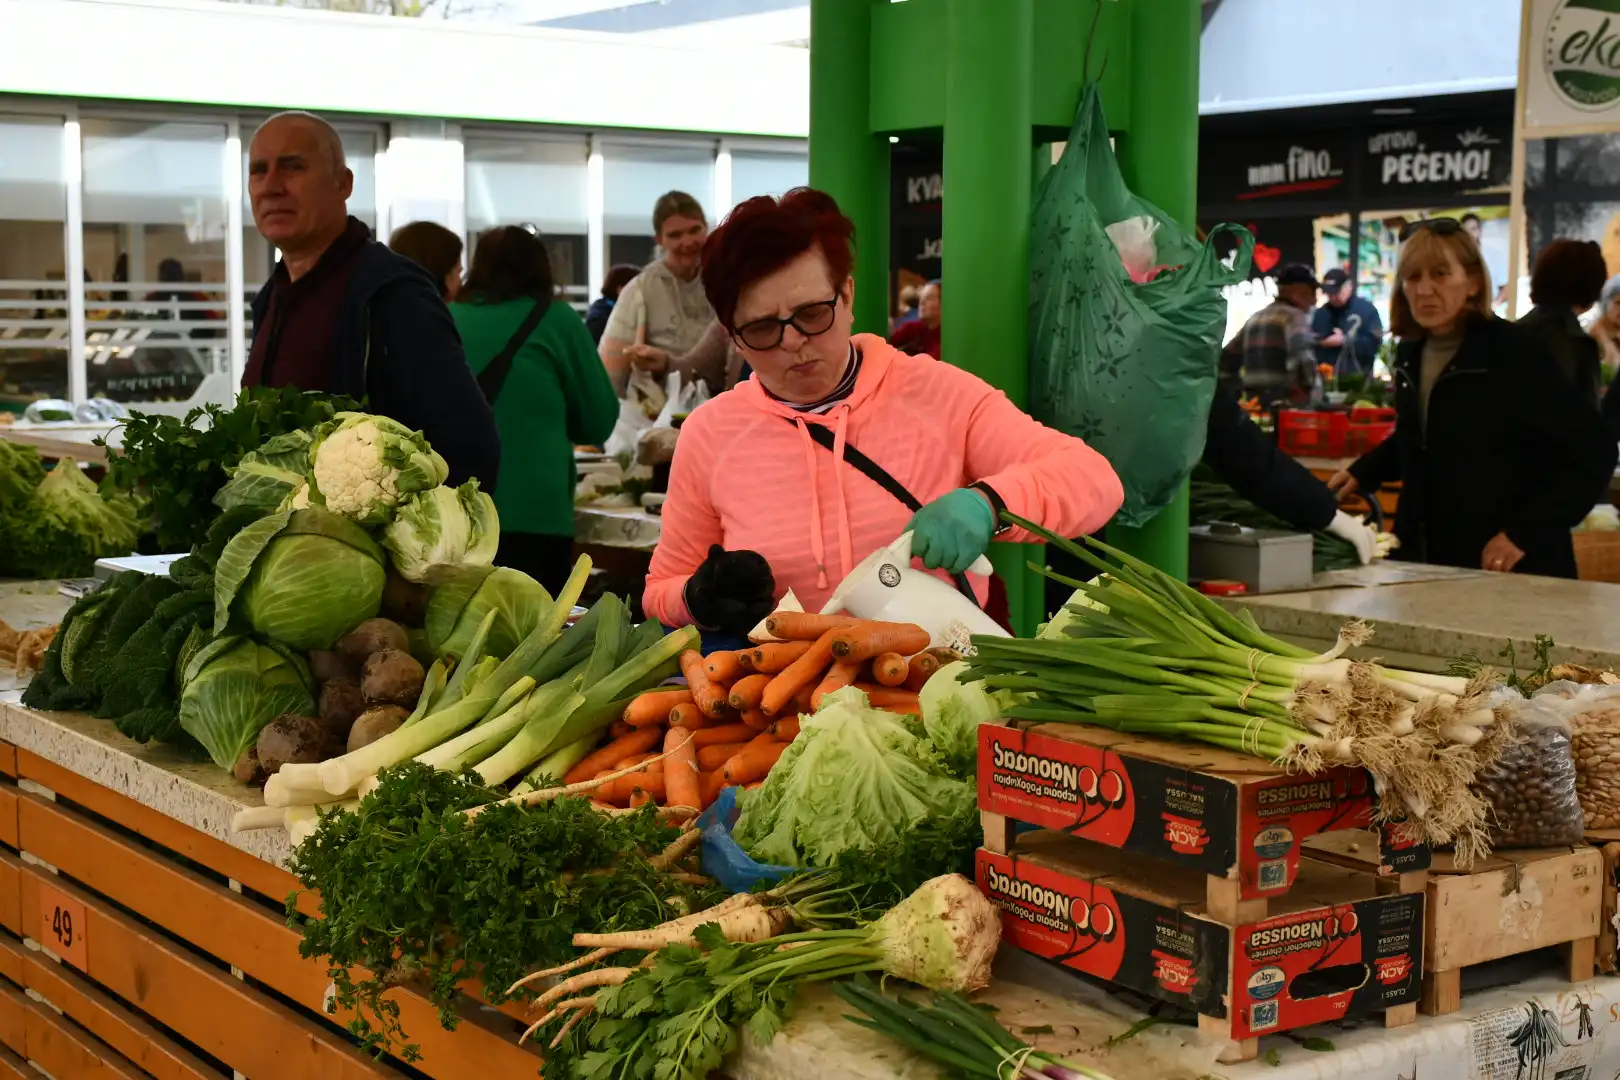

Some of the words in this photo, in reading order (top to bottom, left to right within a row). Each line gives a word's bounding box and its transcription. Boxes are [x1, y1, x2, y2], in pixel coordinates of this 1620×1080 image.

[1381, 143, 1491, 184] PEČENO!
[994, 741, 1077, 790] Νάουσας
[993, 774, 1042, 796] Ροδοχωρίου
[1257, 780, 1331, 805] Naoussa
[1043, 787, 1077, 804] κεράσια
[1256, 805, 1291, 818] cherries
[1291, 799, 1331, 813] Rodochori
[1168, 829, 1199, 847] ACN
[988, 866, 1070, 920] Νάουσας
[52, 905, 73, 948] 49
[1036, 914, 1069, 932] κεράσια
[1252, 920, 1323, 947] Naoussa
[1377, 933, 1410, 944] NAOUSSA
[1251, 946, 1283, 961] cherries
[1283, 940, 1323, 955] Rodochori
[1159, 967, 1189, 986] ACN
[1380, 965, 1405, 979] ACN
[1385, 988, 1406, 998] CLASS
